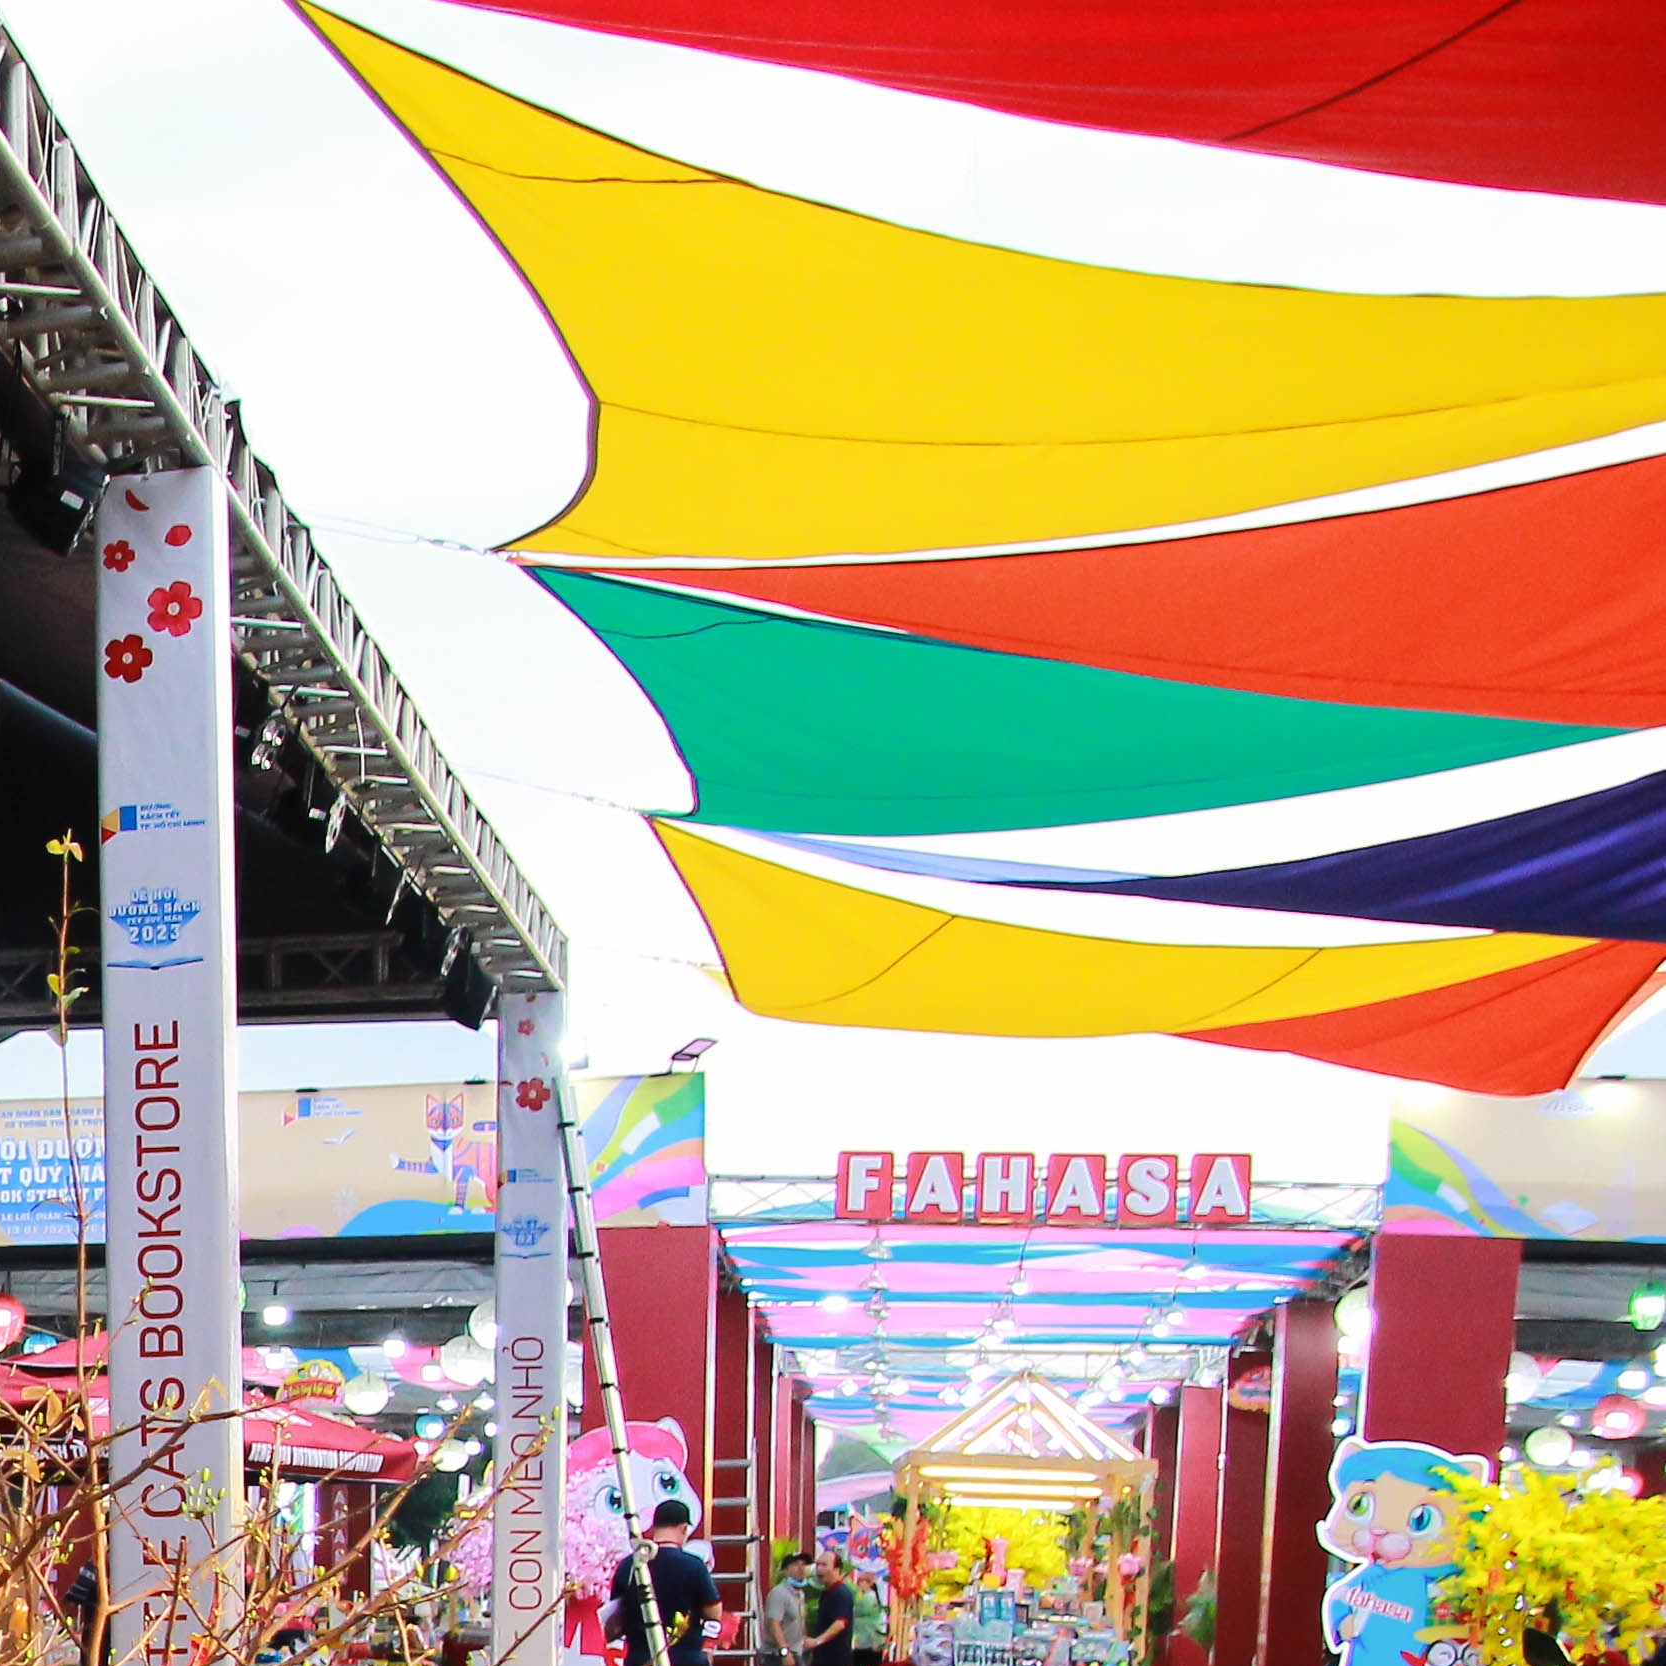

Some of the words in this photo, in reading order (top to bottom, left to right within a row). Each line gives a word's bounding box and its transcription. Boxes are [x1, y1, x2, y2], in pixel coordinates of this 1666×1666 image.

[129, 924, 181, 943] 2023
[19, 1159, 60, 1188] QUÝ
[134, 1020, 185, 1358] BOOKSTORE
[847, 1156, 1244, 1218] FAHASA
[502, 1336, 545, 1422] NHỎ
[507, 1528, 544, 1612] CON
[1348, 1586, 1414, 1623] fahasa
